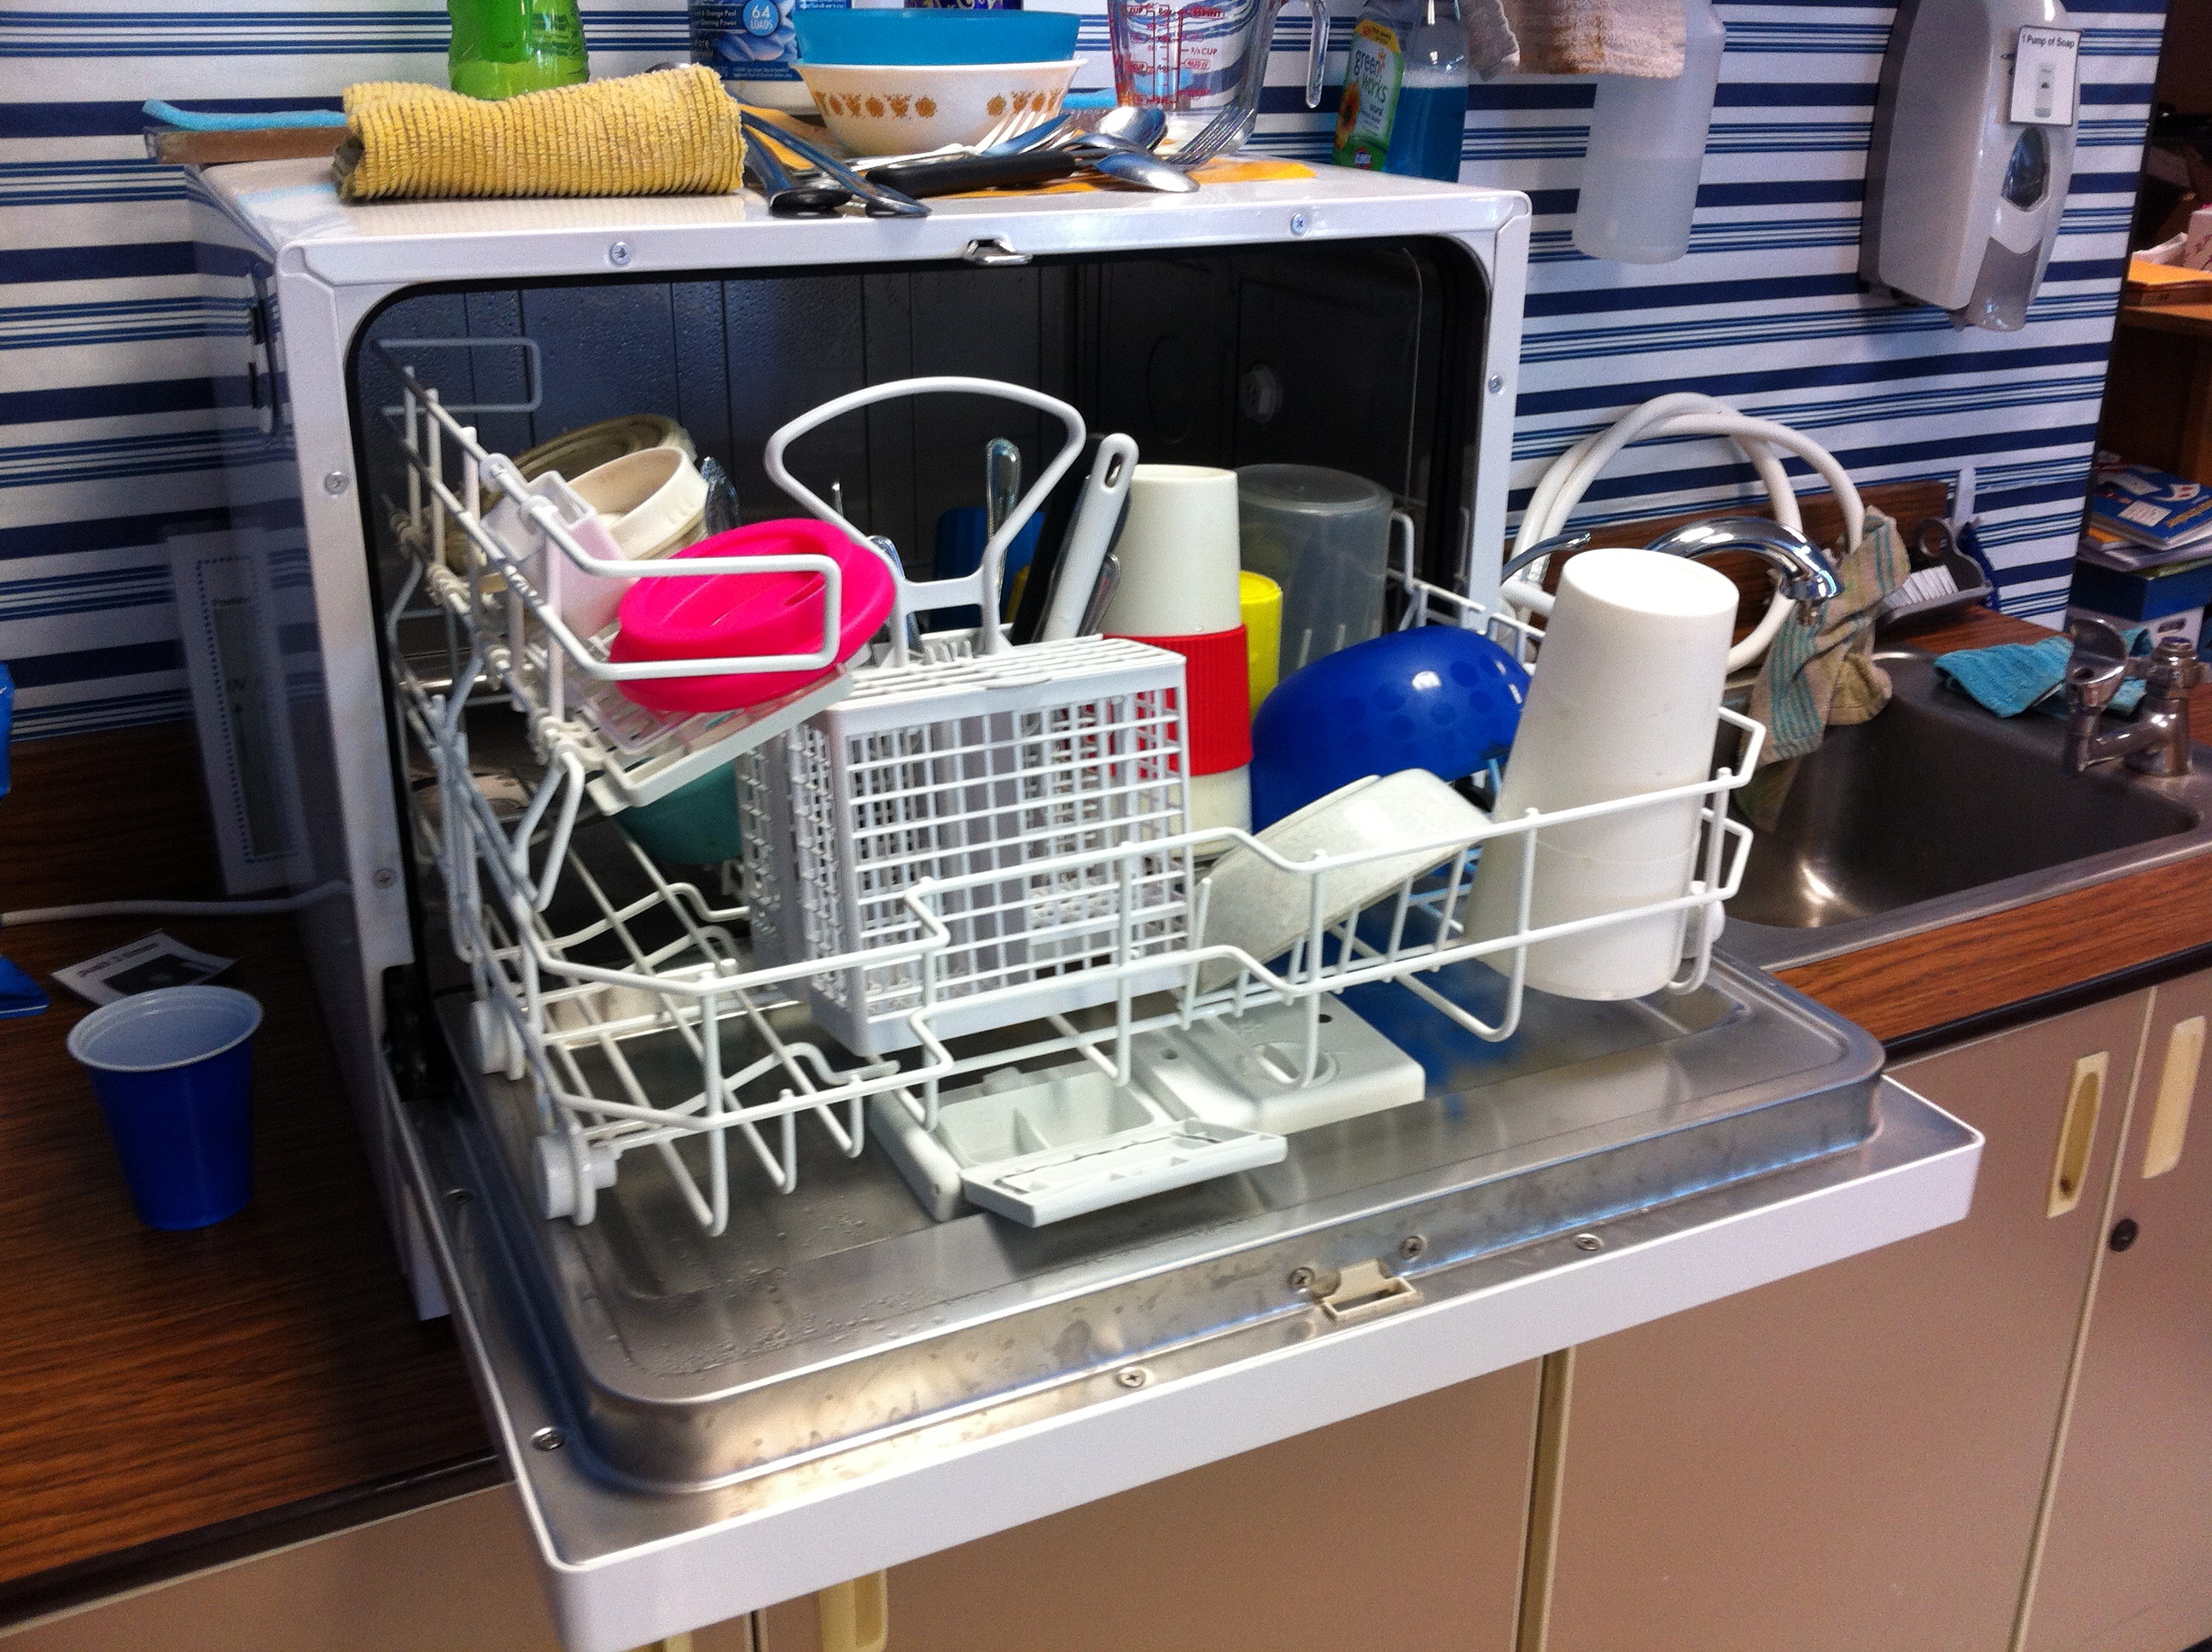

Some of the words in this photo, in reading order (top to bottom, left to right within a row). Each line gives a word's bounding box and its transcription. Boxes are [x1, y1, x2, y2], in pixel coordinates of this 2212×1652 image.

[752, 4, 771, 18] 64
[750, 19, 774, 30] LOADS
[2028, 34, 2046, 47] Pump
[2048, 38, 2055, 46] of
[2057, 38, 2075, 49] Soap
[1353, 50, 1381, 76] green
[1362, 74, 1388, 103] works
